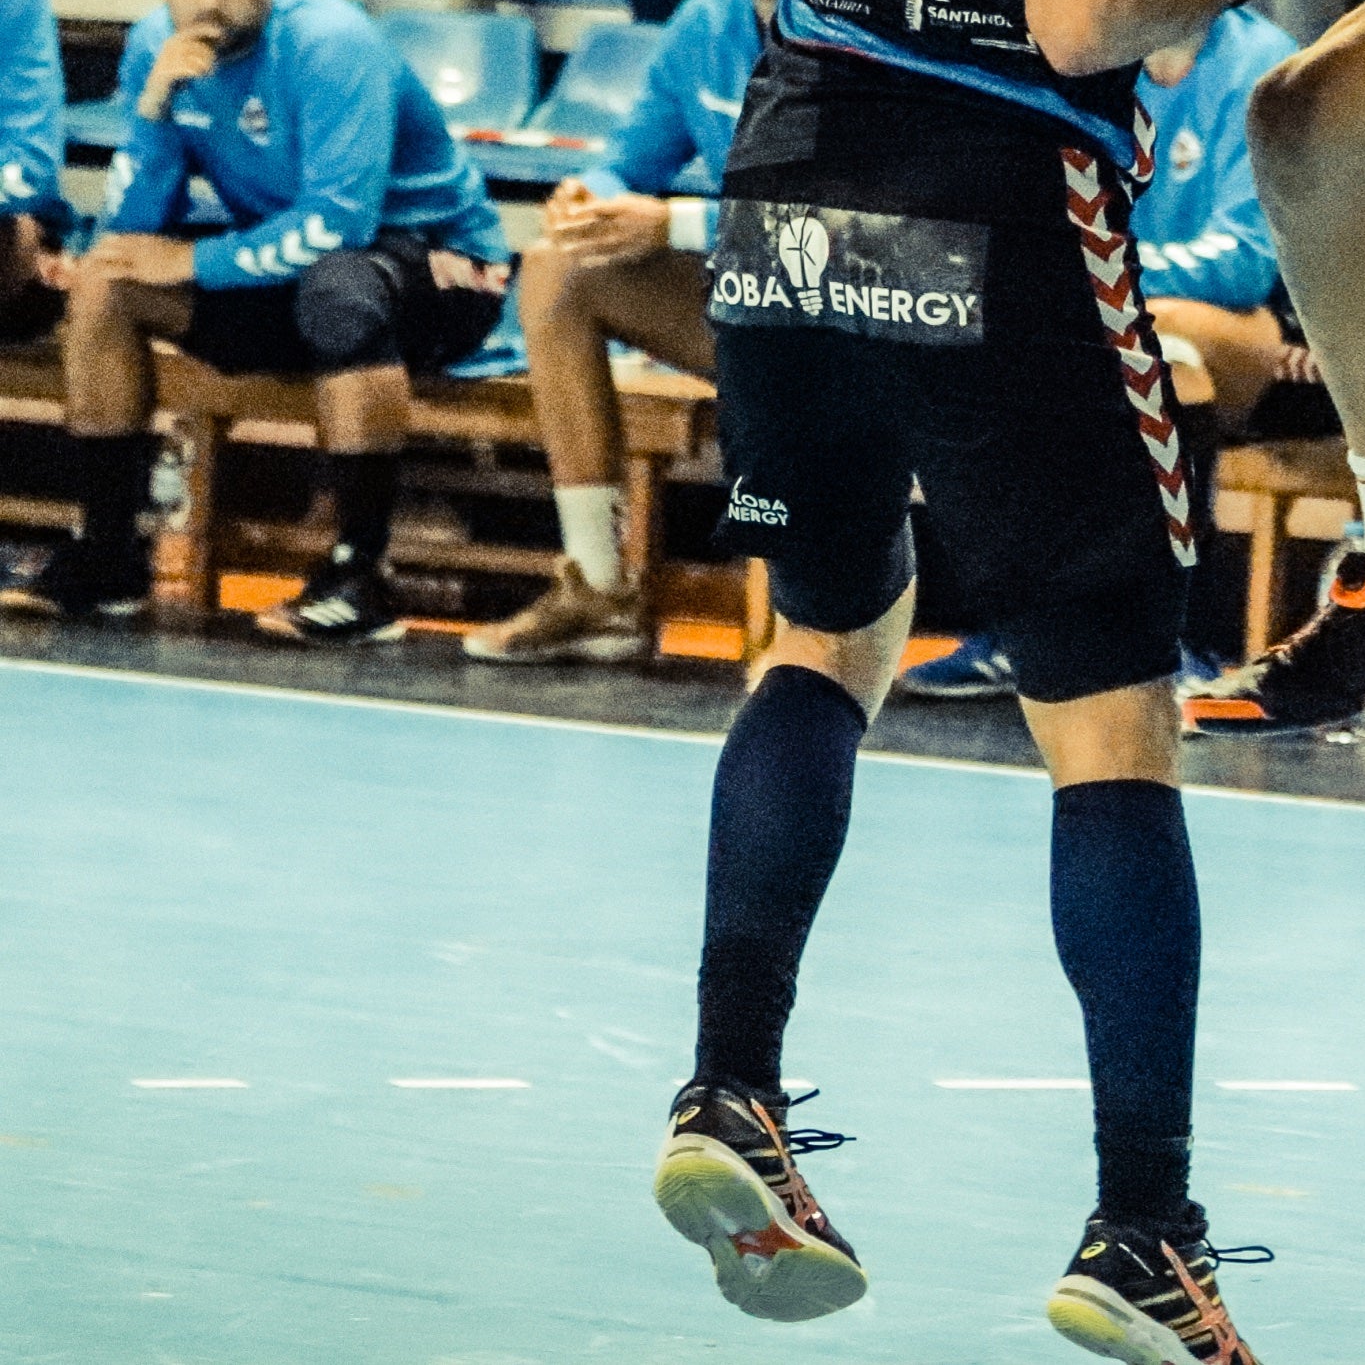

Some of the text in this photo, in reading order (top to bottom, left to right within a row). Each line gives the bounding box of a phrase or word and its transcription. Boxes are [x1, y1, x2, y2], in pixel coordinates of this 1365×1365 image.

[927, 5, 1013, 29] SANTAND
[829, 281, 977, 328] ENERGY
[728, 504, 789, 527] NERGY
